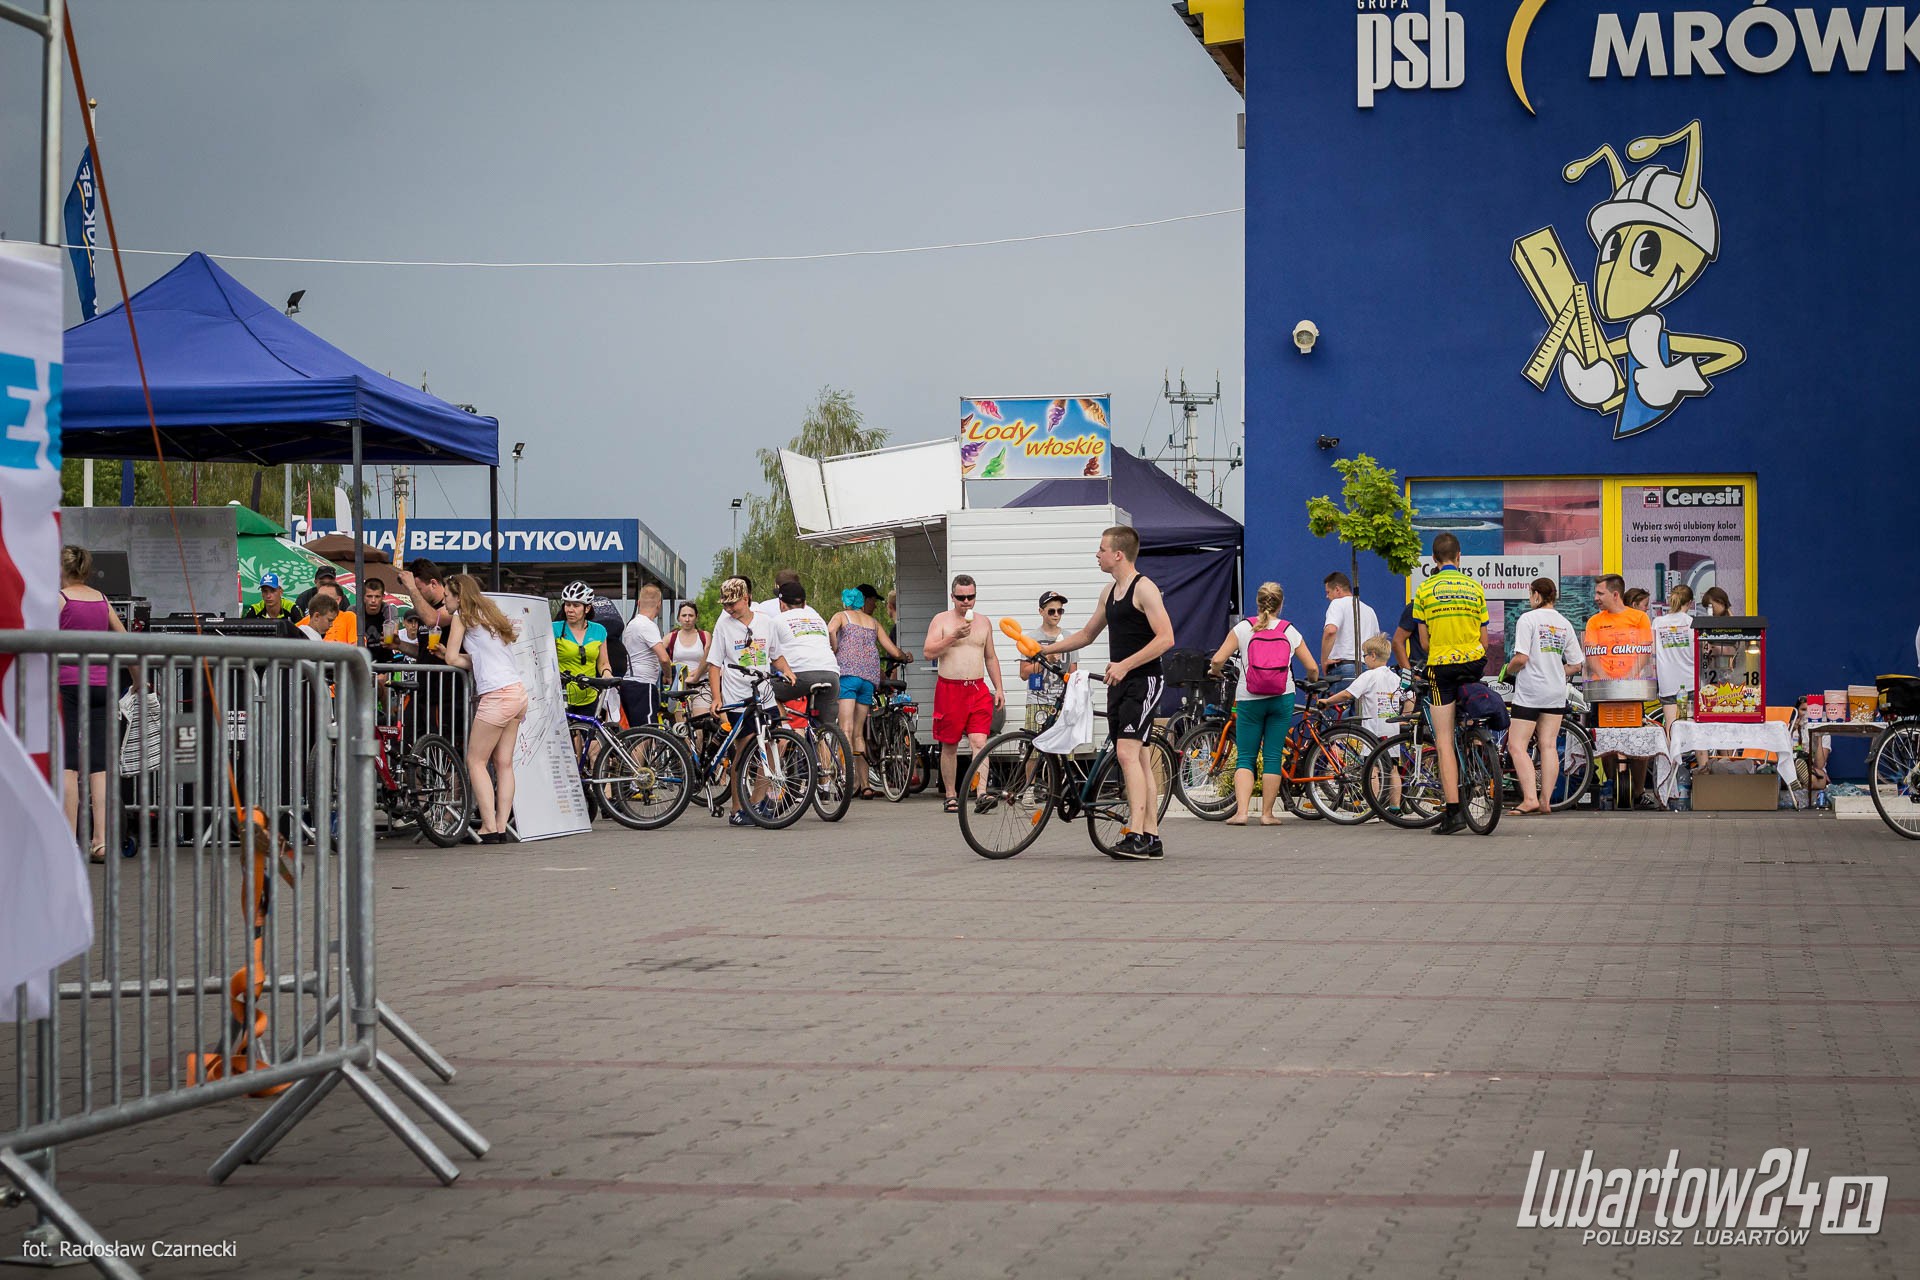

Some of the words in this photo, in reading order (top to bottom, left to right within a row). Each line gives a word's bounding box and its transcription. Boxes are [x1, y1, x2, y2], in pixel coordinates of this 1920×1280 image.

[1357, 0, 1465, 108] psb
[968, 420, 1036, 446] Lody
[1026, 435, 1104, 456] włoskie
[1666, 487, 1741, 506] Ceresit
[1632, 521, 1662, 532] Wybierz
[1664, 522, 1681, 531] swój
[1683, 521, 1715, 531] ulubiony
[1717, 520, 1737, 530] kolor
[410, 530, 624, 551] BEZDOTYKOWA
[1631, 534, 1648, 542] ciesz
[1650, 534, 1661, 544] się
[1663, 534, 1711, 544] wymarzonym
[1713, 533, 1743, 542] domem.
[1477, 562, 1491, 577] of
[1494, 562, 1539, 577] Nature
[1585, 644, 1608, 657] Wata
[1612, 643, 1652, 655] cukrowa
[1743, 671, 1760, 686] 18
